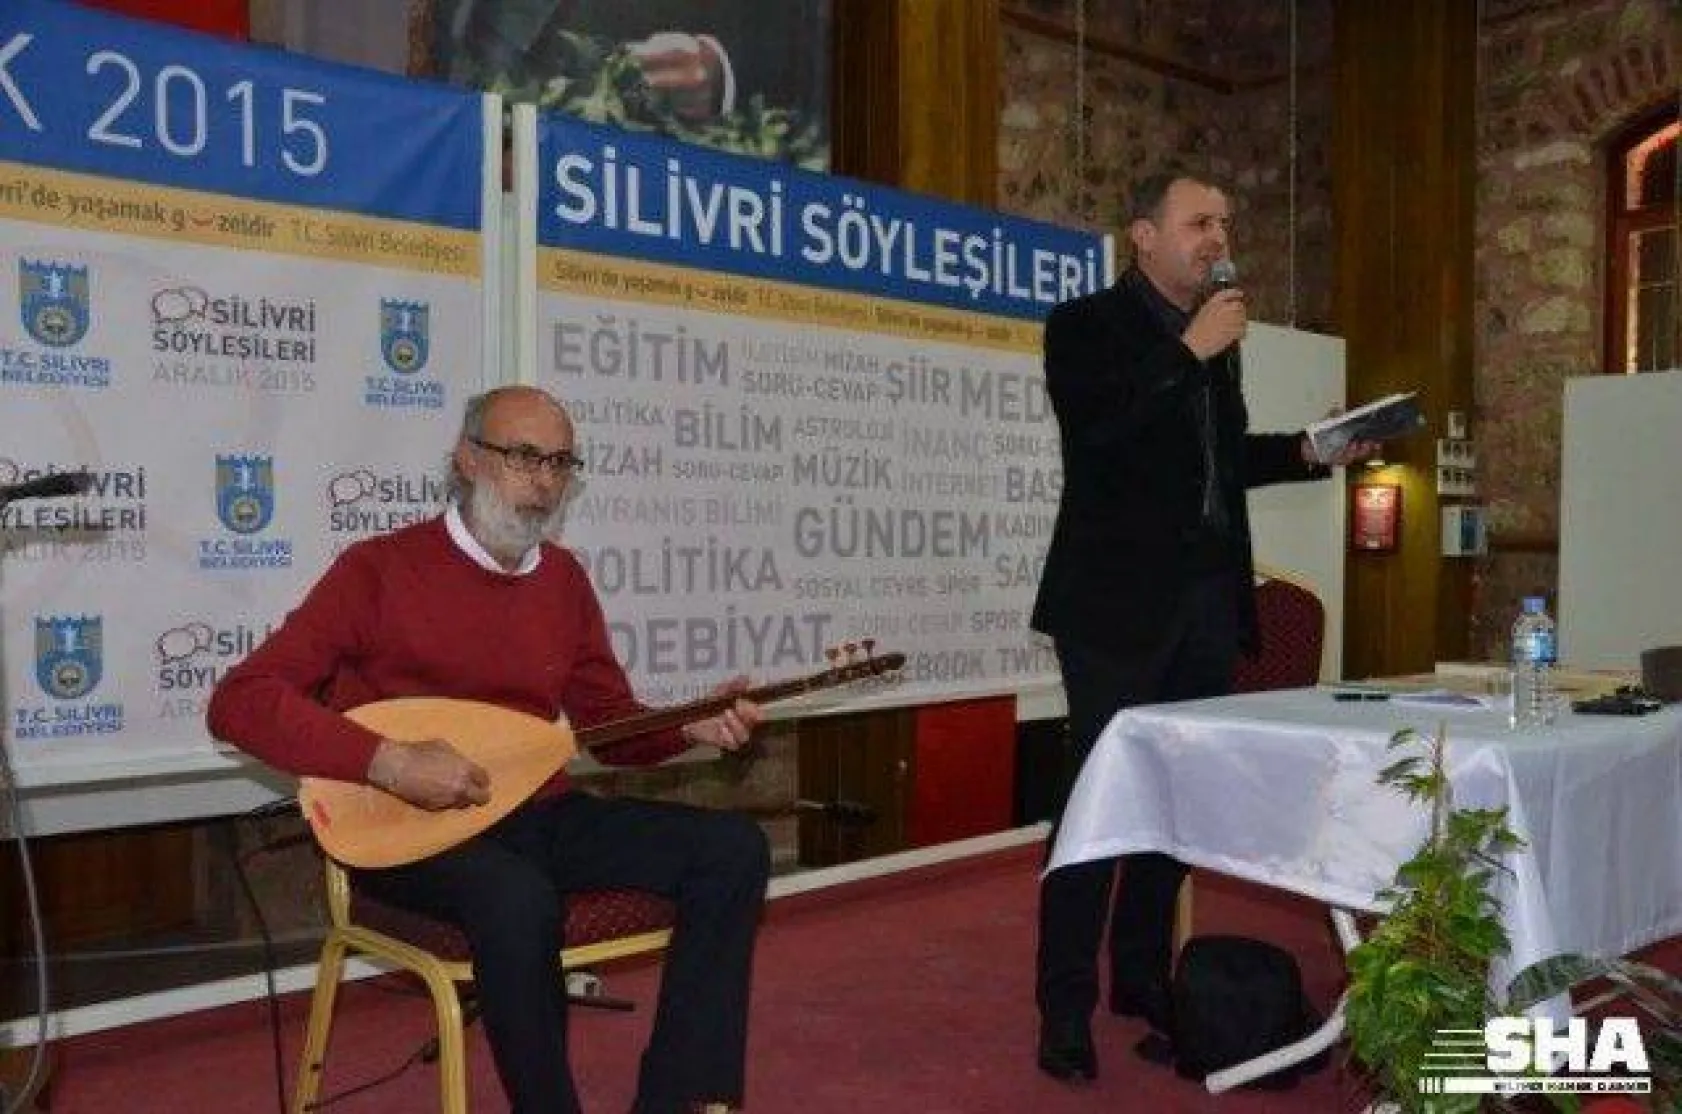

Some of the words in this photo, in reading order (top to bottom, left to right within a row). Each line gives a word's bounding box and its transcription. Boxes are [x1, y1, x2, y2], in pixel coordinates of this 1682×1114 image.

[86, 50, 328, 176] 2015
[67, 193, 166, 224] yaşamak
[555, 146, 783, 257] SİLİVRİ
[801, 195, 1097, 303] SÖYLEŞİLERİ
[212, 295, 317, 332] SİLİVRİ
[152, 327, 317, 364] SÖYLEŞİLERİ
[554, 314, 729, 386] EĞİTİM
[886, 355, 952, 405] ŞİİR
[565, 396, 664, 427] OLİTİKA
[674, 404, 782, 451] BİLİM
[574, 436, 664, 476] İZAH
[793, 446, 893, 490] MÜZİK
[794, 494, 990, 559] GÜNDEM
